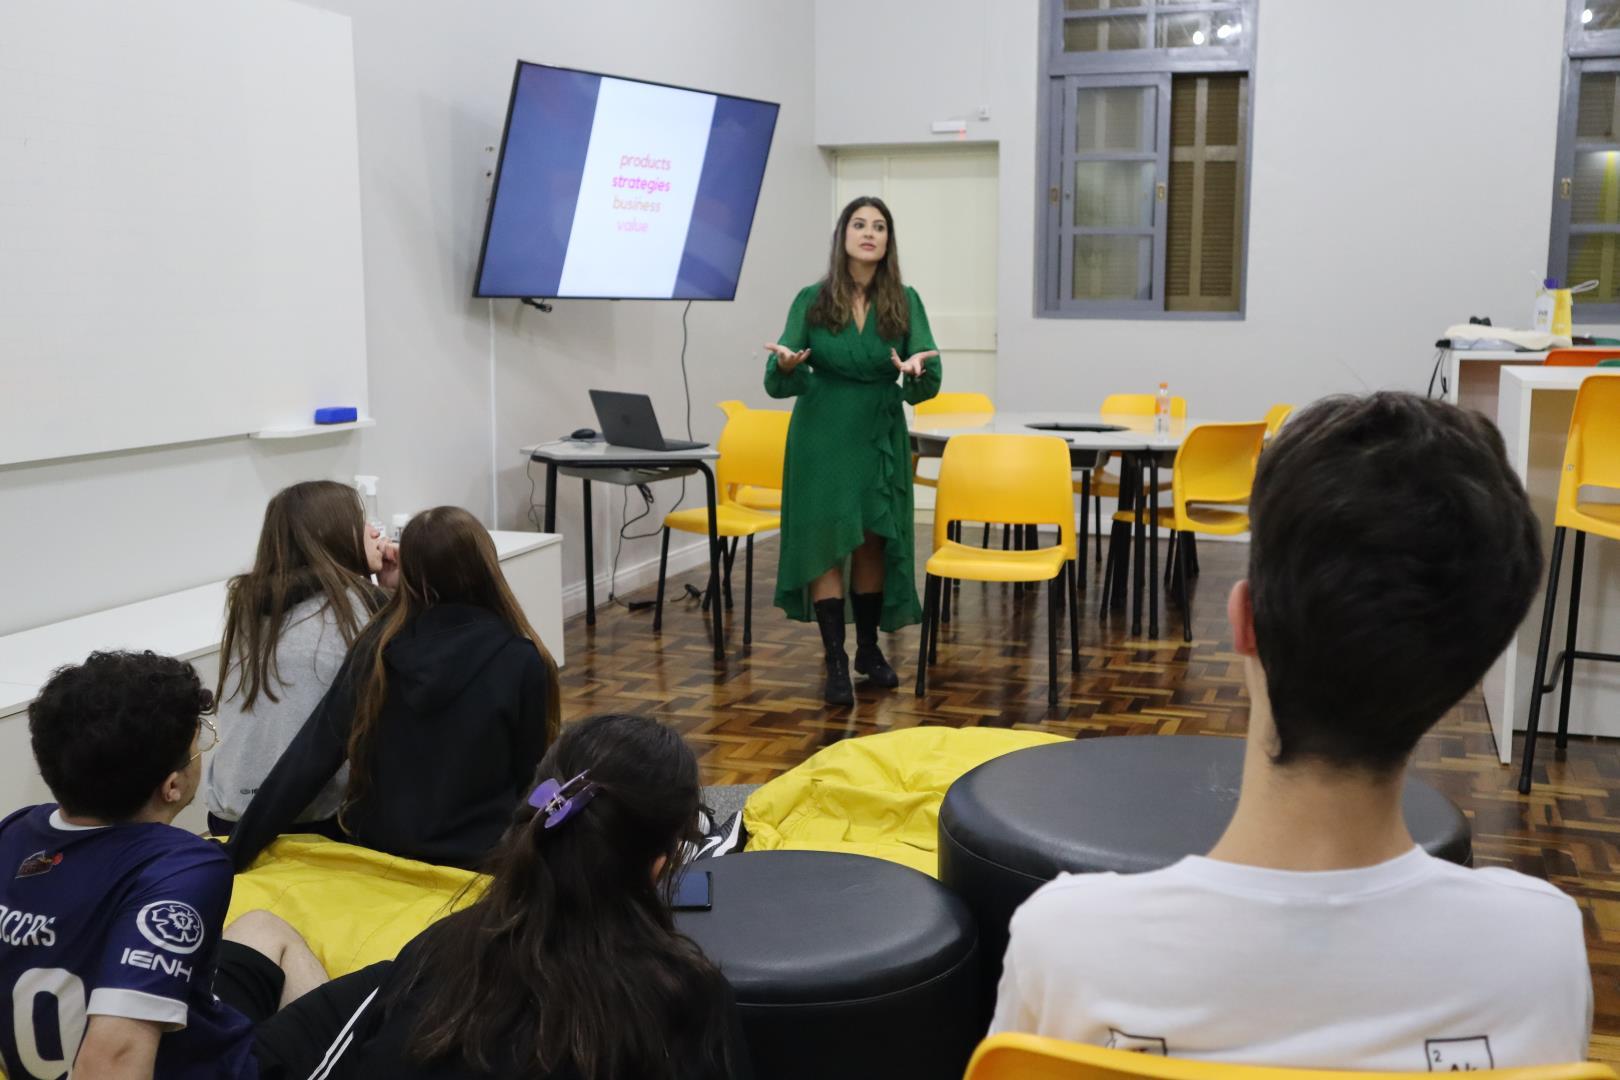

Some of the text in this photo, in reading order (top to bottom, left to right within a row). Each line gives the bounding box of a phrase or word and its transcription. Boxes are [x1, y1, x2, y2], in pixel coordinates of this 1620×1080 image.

[619, 153, 671, 171] products
[612, 175, 671, 194] strategies
[613, 195, 661, 213] business
[616, 217, 648, 232] value
[120, 947, 193, 983] IENH
[1433, 1049, 1442, 1063] 2
